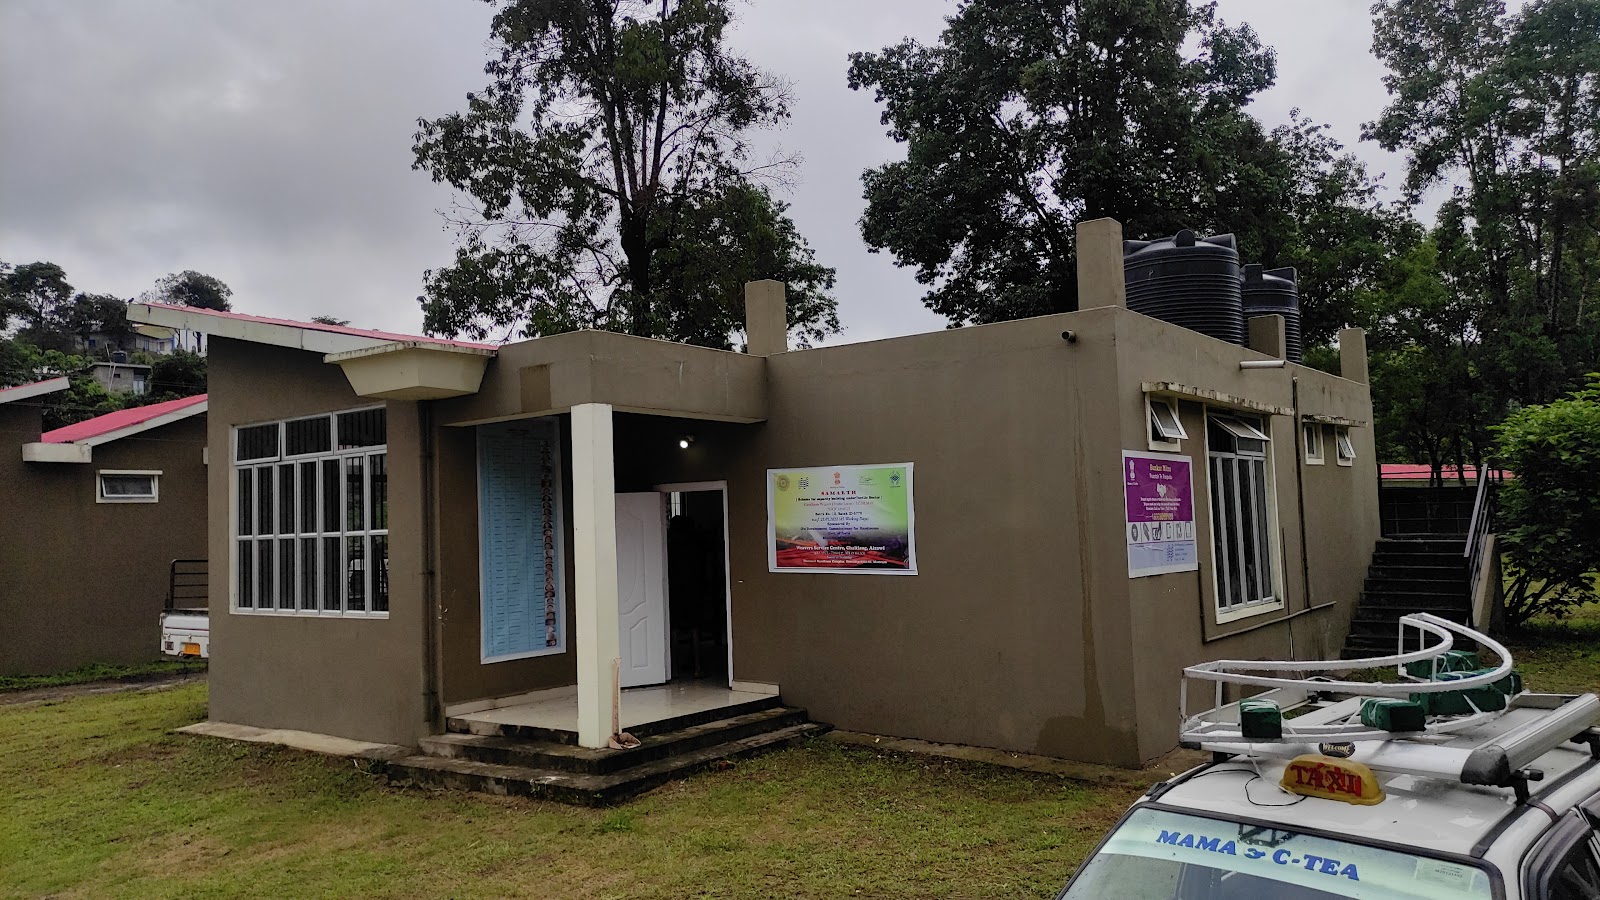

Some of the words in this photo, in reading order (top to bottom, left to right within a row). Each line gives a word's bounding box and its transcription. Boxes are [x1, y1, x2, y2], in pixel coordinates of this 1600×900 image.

[1322, 742, 1352, 754] WELCOME
[1290, 762, 1361, 796] TAXI
[1156, 830, 1236, 855] MAMA
[1272, 848, 1360, 881] C-TEA
